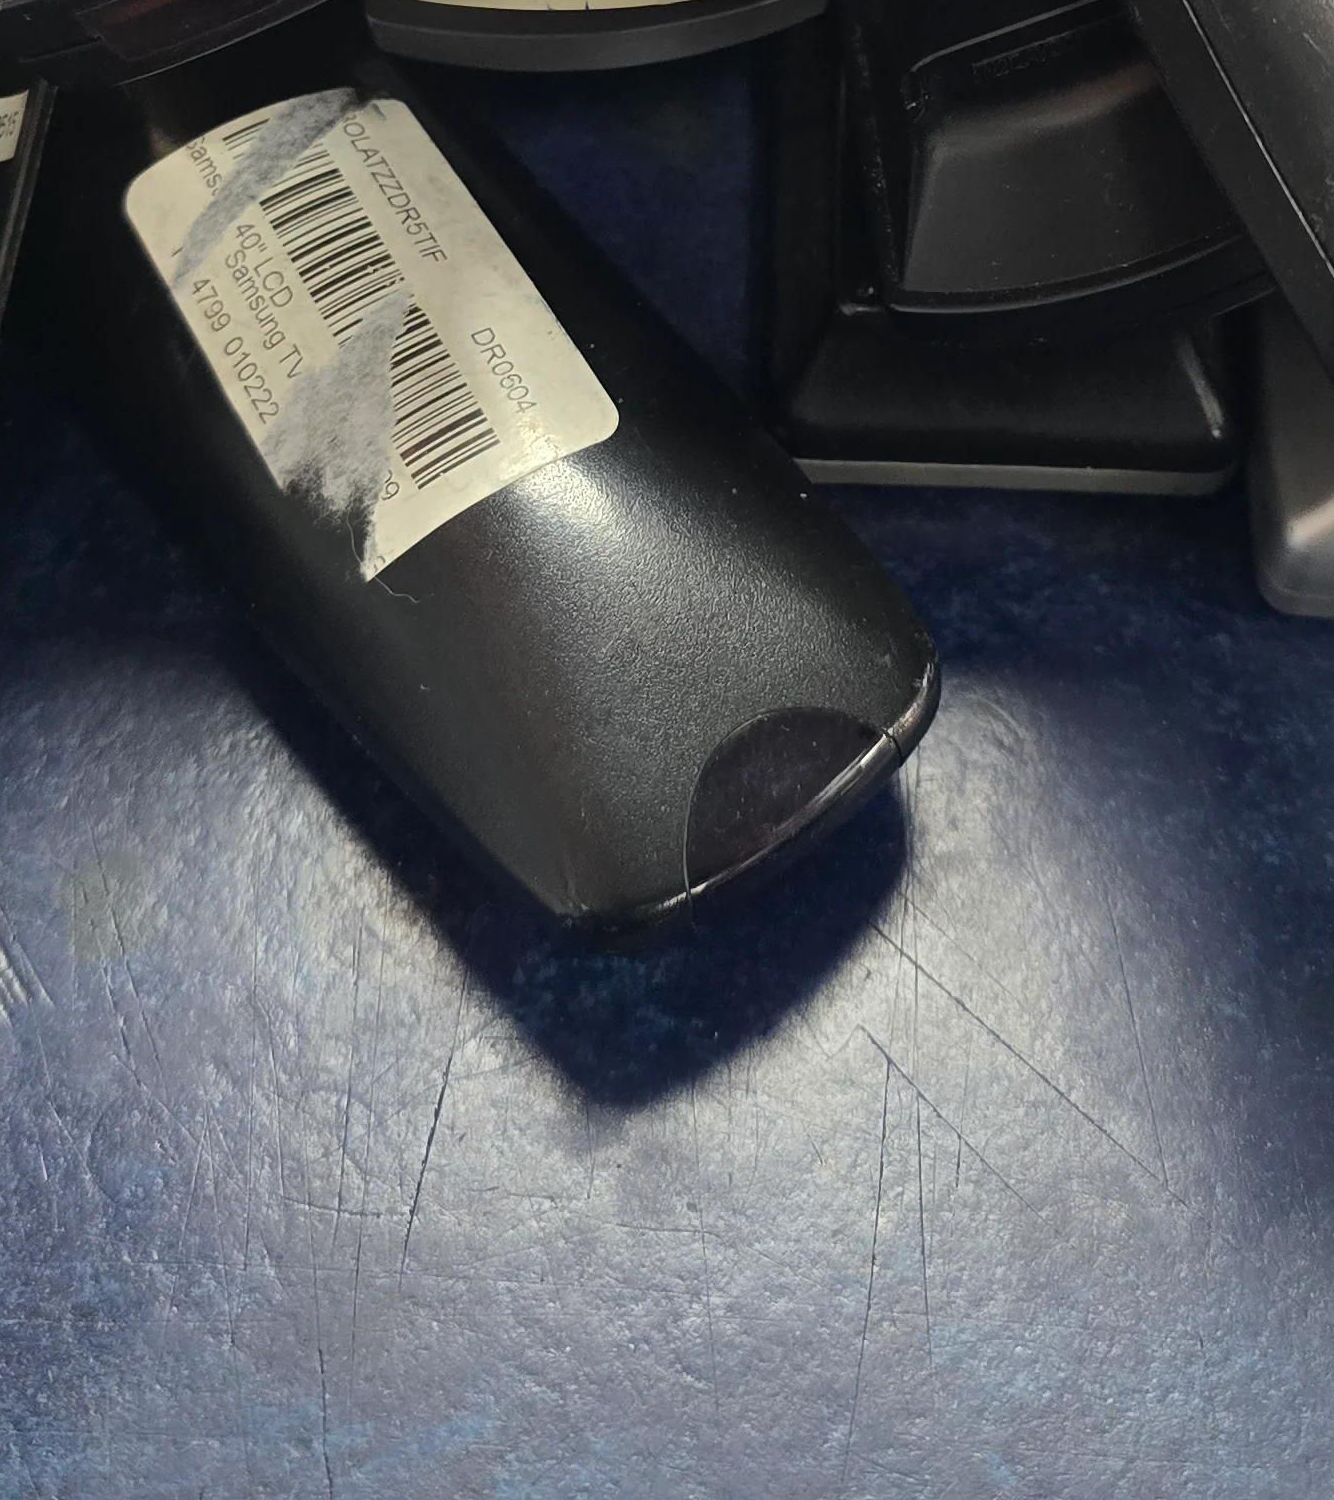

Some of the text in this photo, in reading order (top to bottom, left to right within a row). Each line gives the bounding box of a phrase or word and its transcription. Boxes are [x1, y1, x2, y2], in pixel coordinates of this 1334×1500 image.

[224, 250, 303, 380] Samsung TV
[254, 258, 295, 309] LCD
[191, 277, 280, 425] 4799 010222
[471, 326, 540, 415] DR0604
